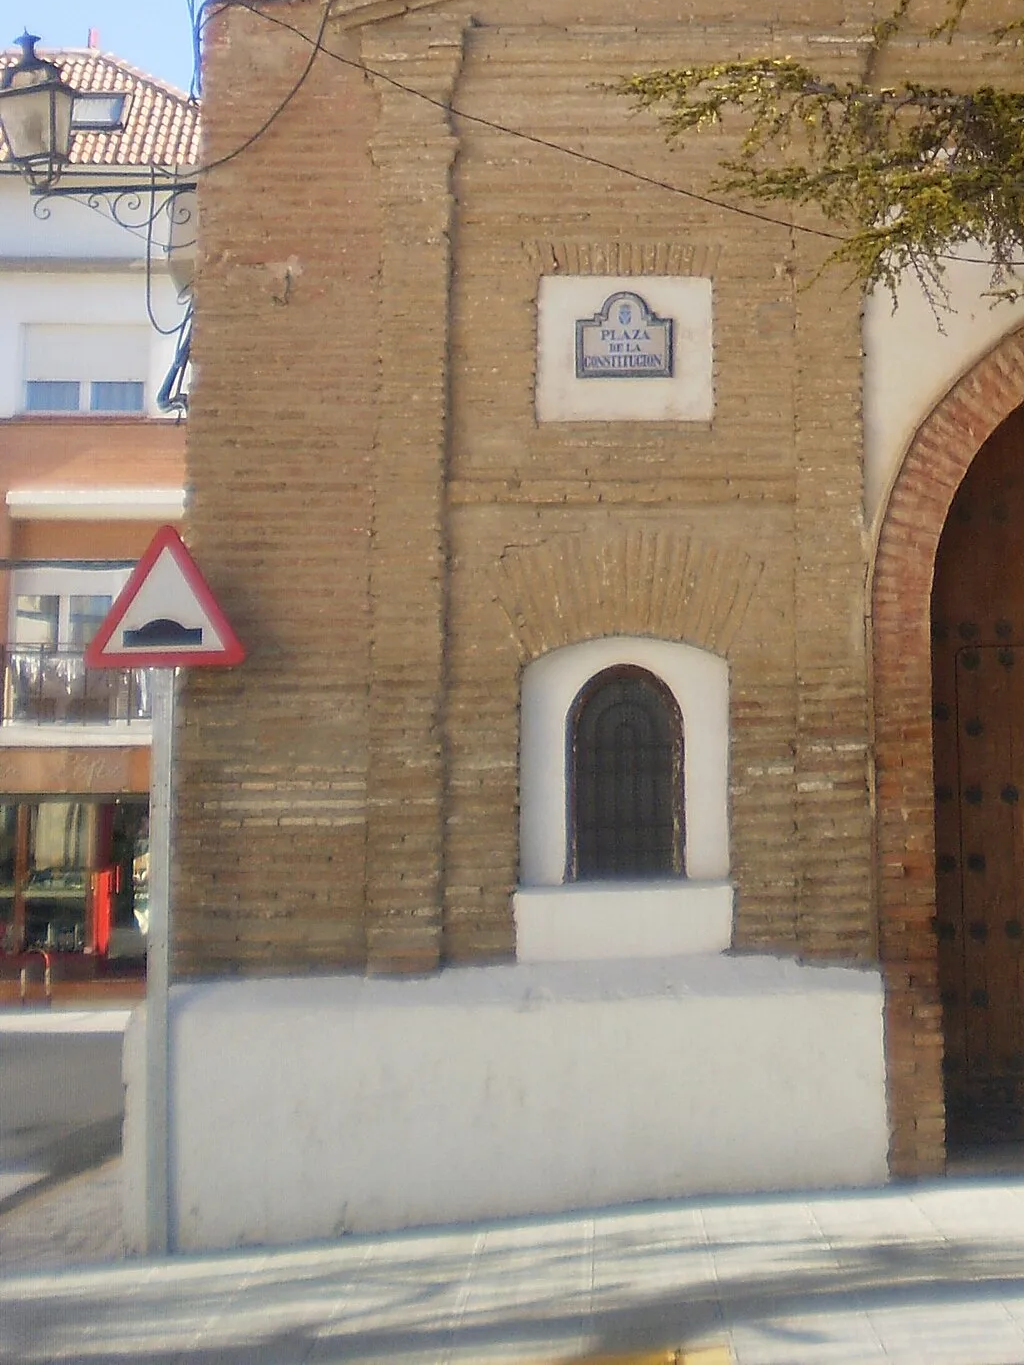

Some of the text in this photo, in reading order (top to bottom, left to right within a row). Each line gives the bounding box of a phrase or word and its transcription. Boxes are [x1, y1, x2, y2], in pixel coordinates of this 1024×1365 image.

[601, 329, 650, 340] PLAZA
[610, 343, 641, 352] DE LA
[584, 354, 662, 367] CONSTITUCION
